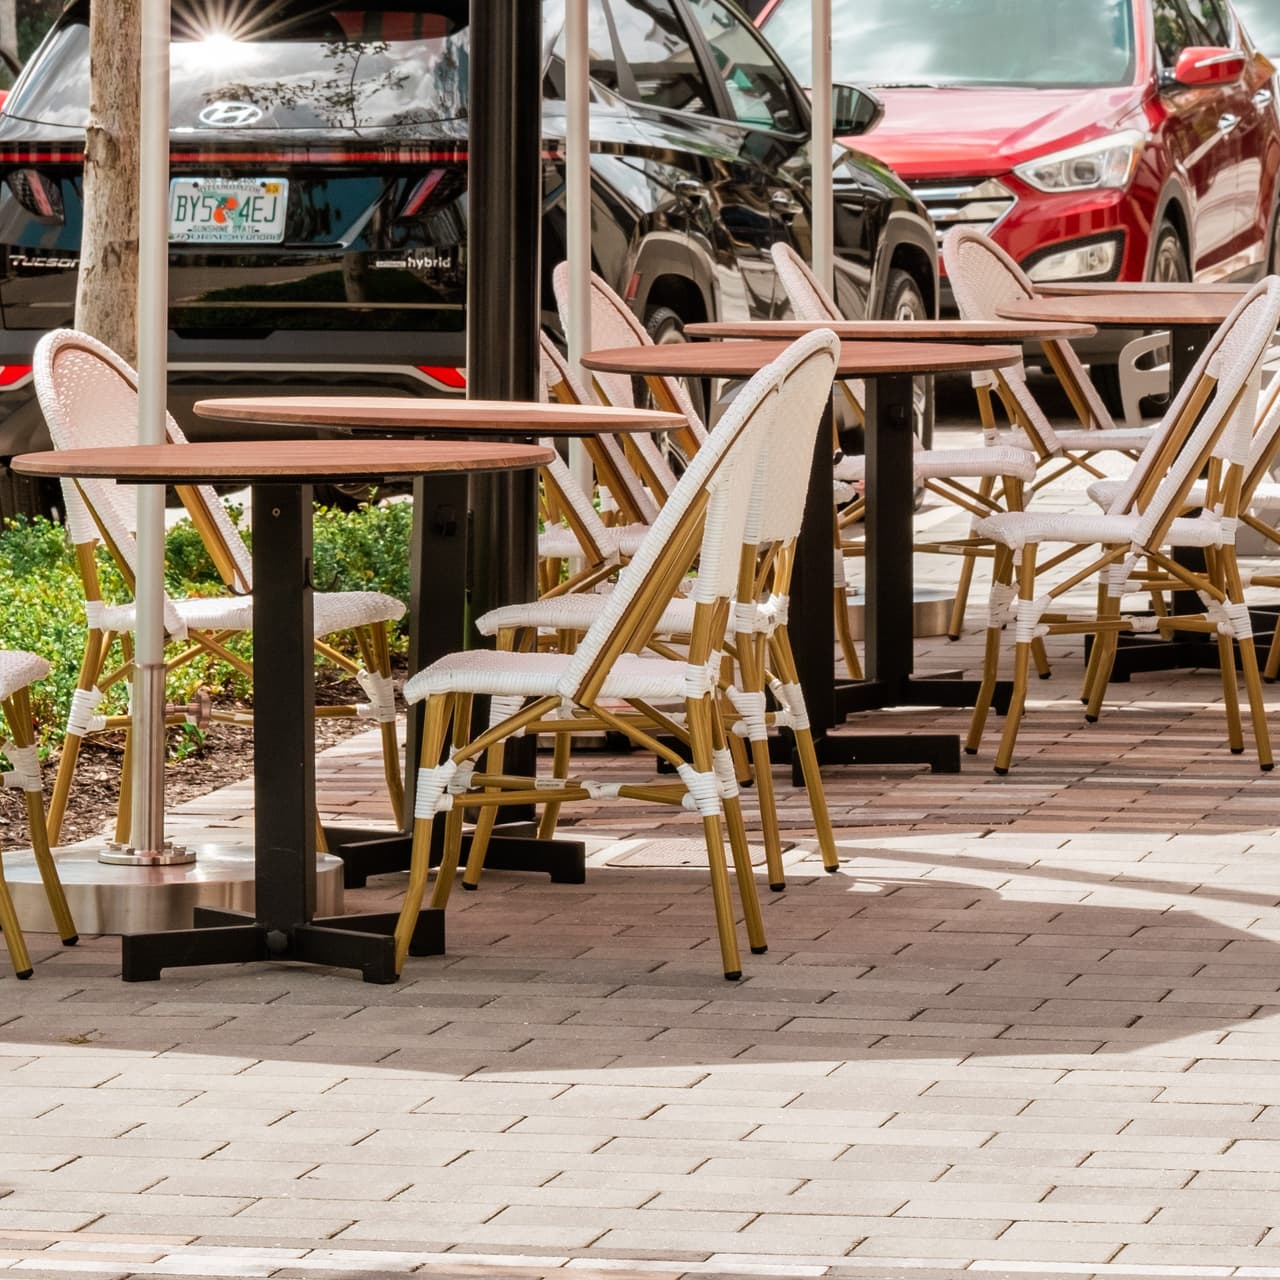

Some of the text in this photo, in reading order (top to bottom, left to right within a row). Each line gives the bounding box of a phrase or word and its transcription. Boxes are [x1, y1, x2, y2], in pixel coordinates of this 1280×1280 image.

[192, 224, 255, 233] SUNSHINE STATE
[407, 256, 451, 269] hybrid
